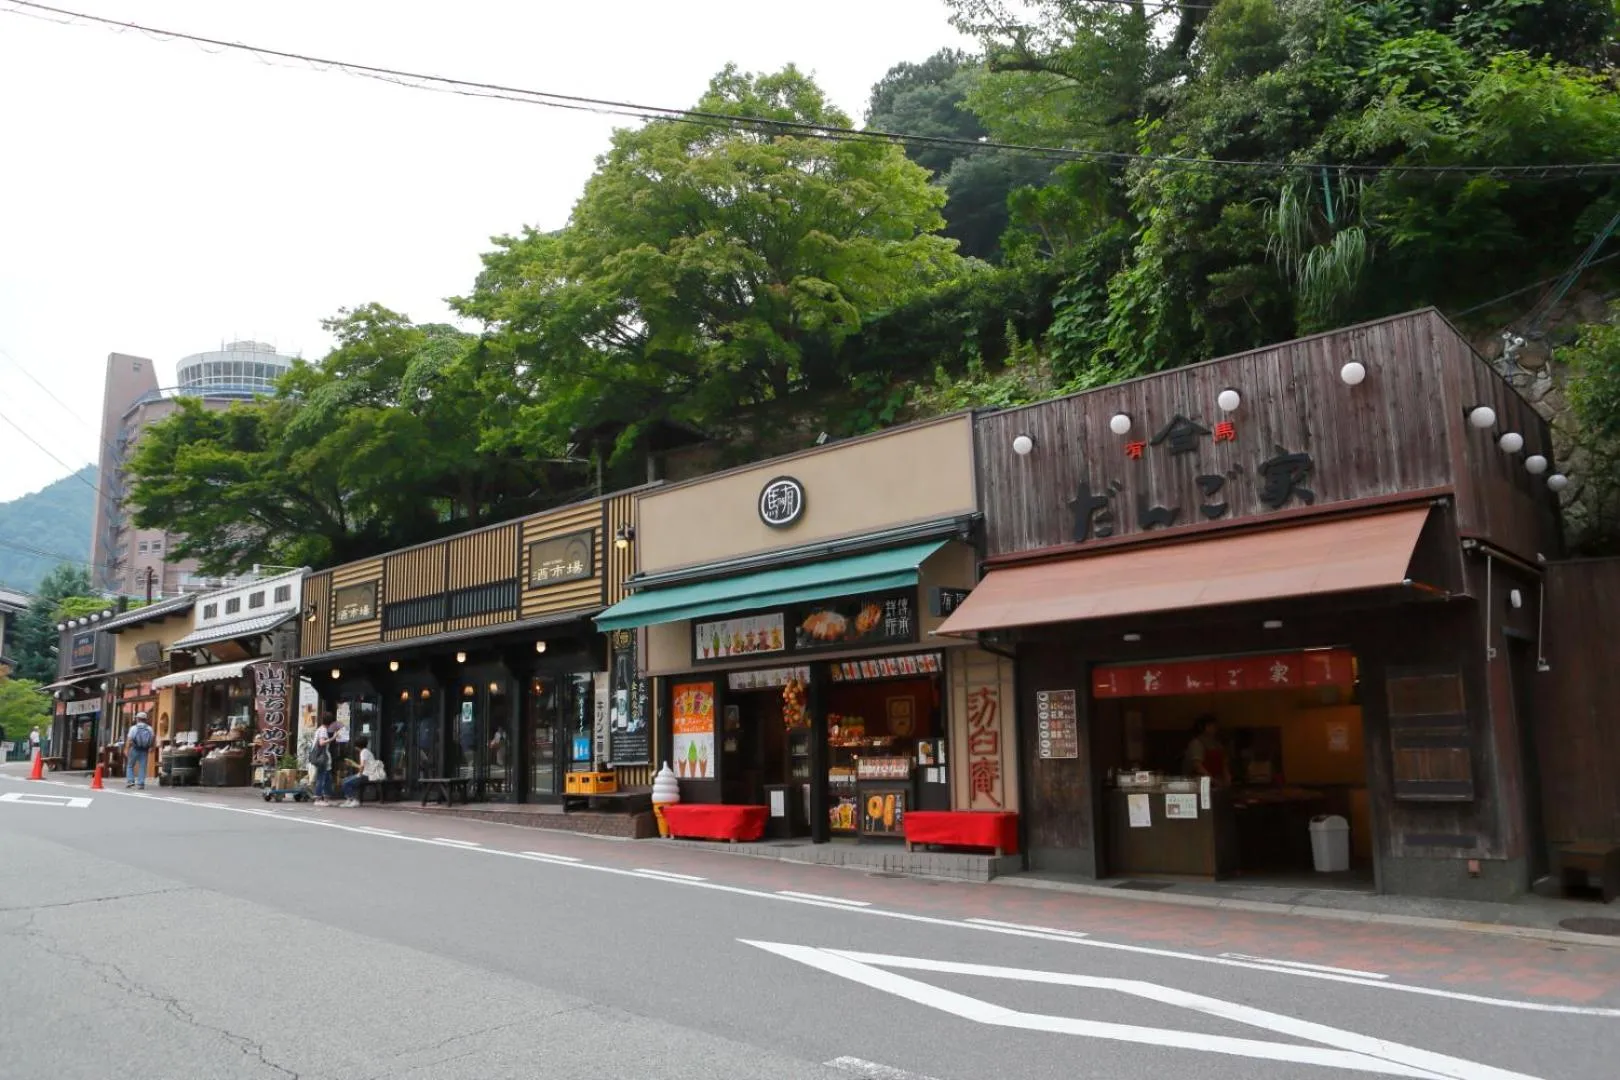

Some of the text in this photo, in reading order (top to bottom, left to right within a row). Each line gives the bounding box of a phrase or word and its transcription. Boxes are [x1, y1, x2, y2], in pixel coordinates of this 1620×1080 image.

[1067, 444, 1315, 543] だんご家
[531, 560, 583, 580] 酒市場
[338, 604, 370, 620] 酒市場
[1143, 660, 1290, 692] だんご家
